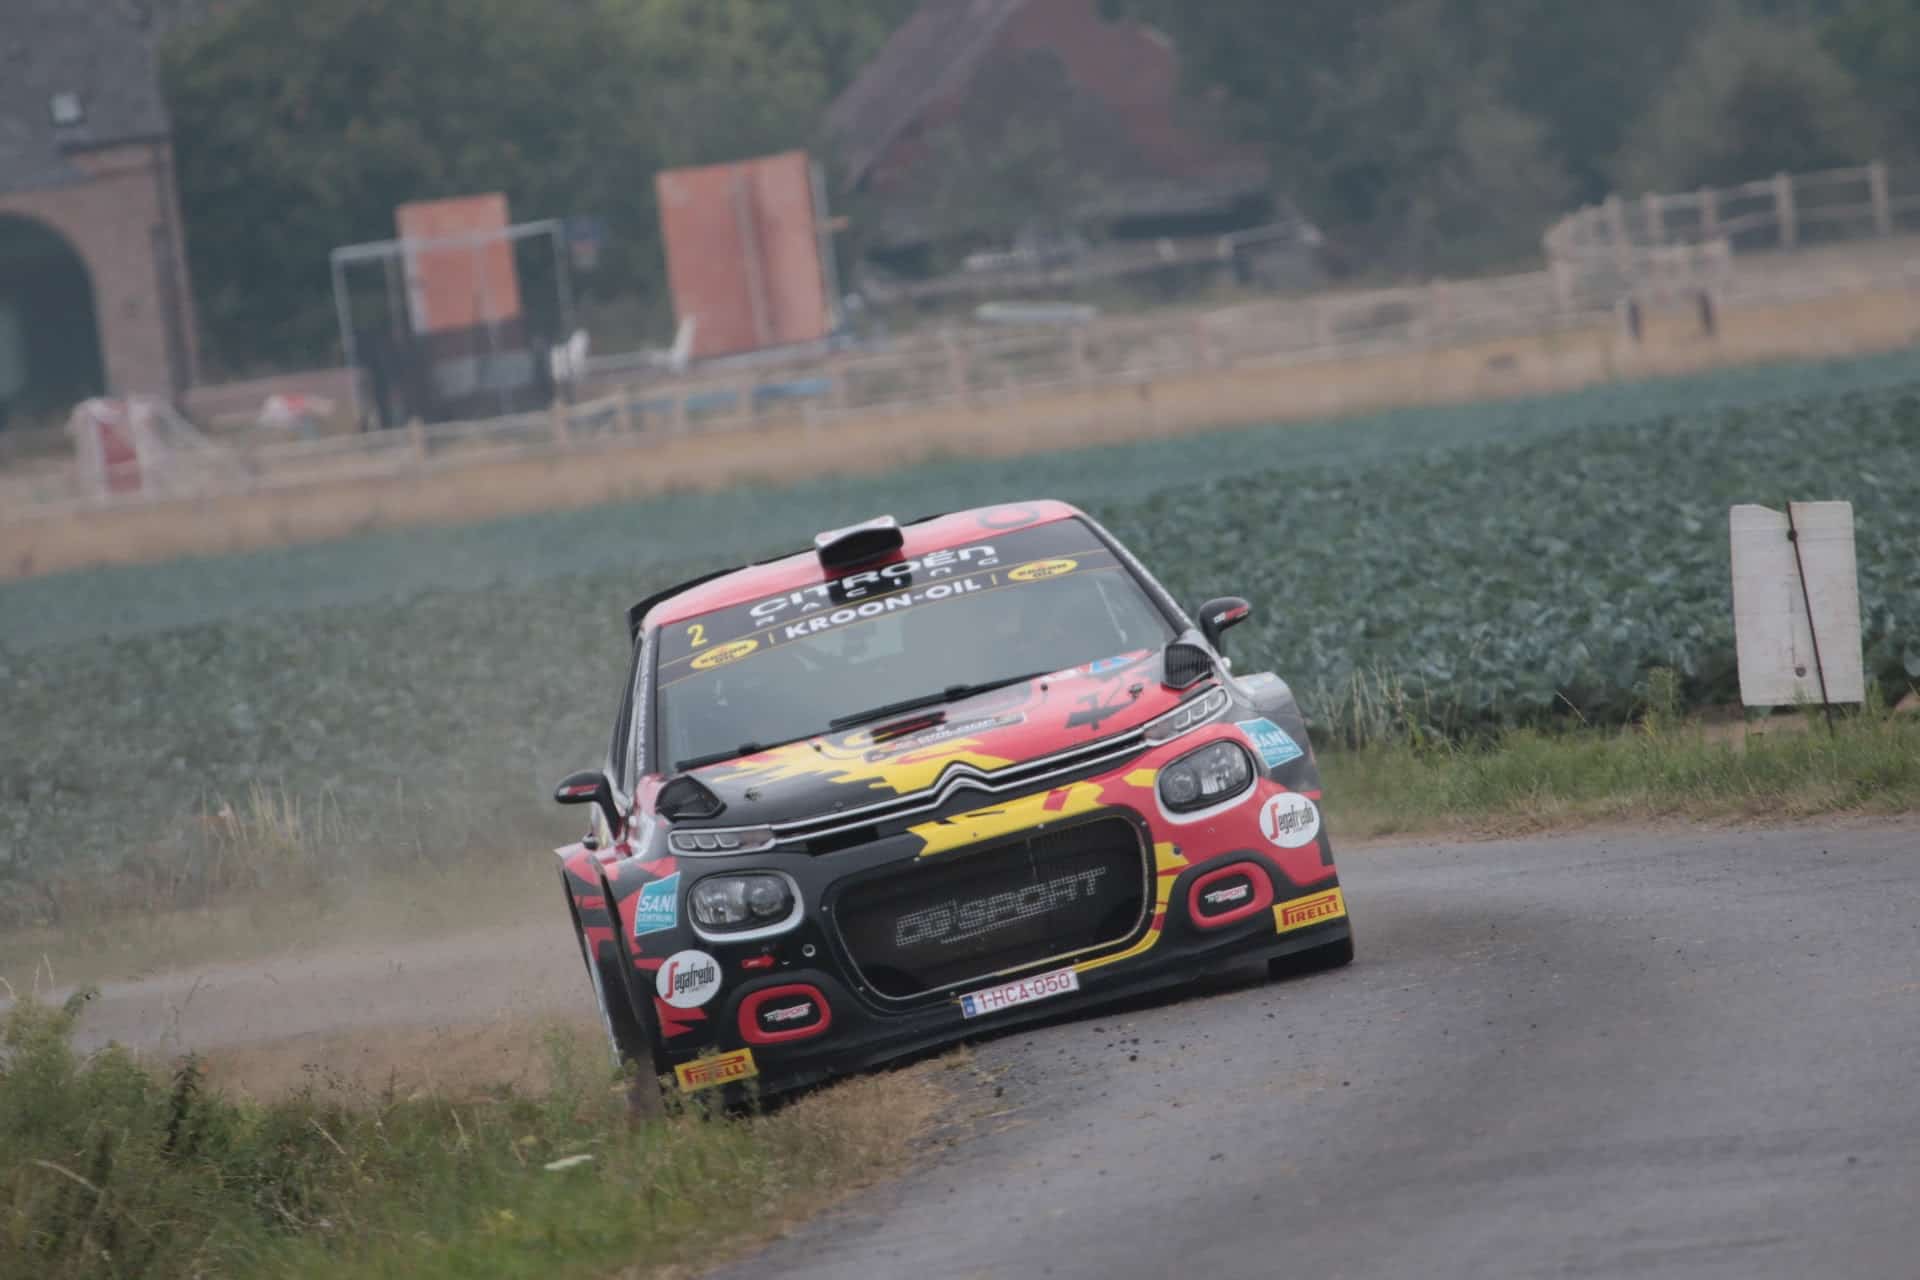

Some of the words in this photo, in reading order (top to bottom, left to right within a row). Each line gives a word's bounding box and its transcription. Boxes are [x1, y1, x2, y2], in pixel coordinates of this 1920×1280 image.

[785, 578, 982, 639] KROON-OIL
[687, 624, 708, 648] 2
[1270, 801, 1315, 840] Segafredo
[638, 895, 674, 912] SANI
[1281, 894, 1339, 927] PIRELLI
[664, 961, 715, 999] Segafredo
[978, 973, 1071, 1010] 1-HCA-050
